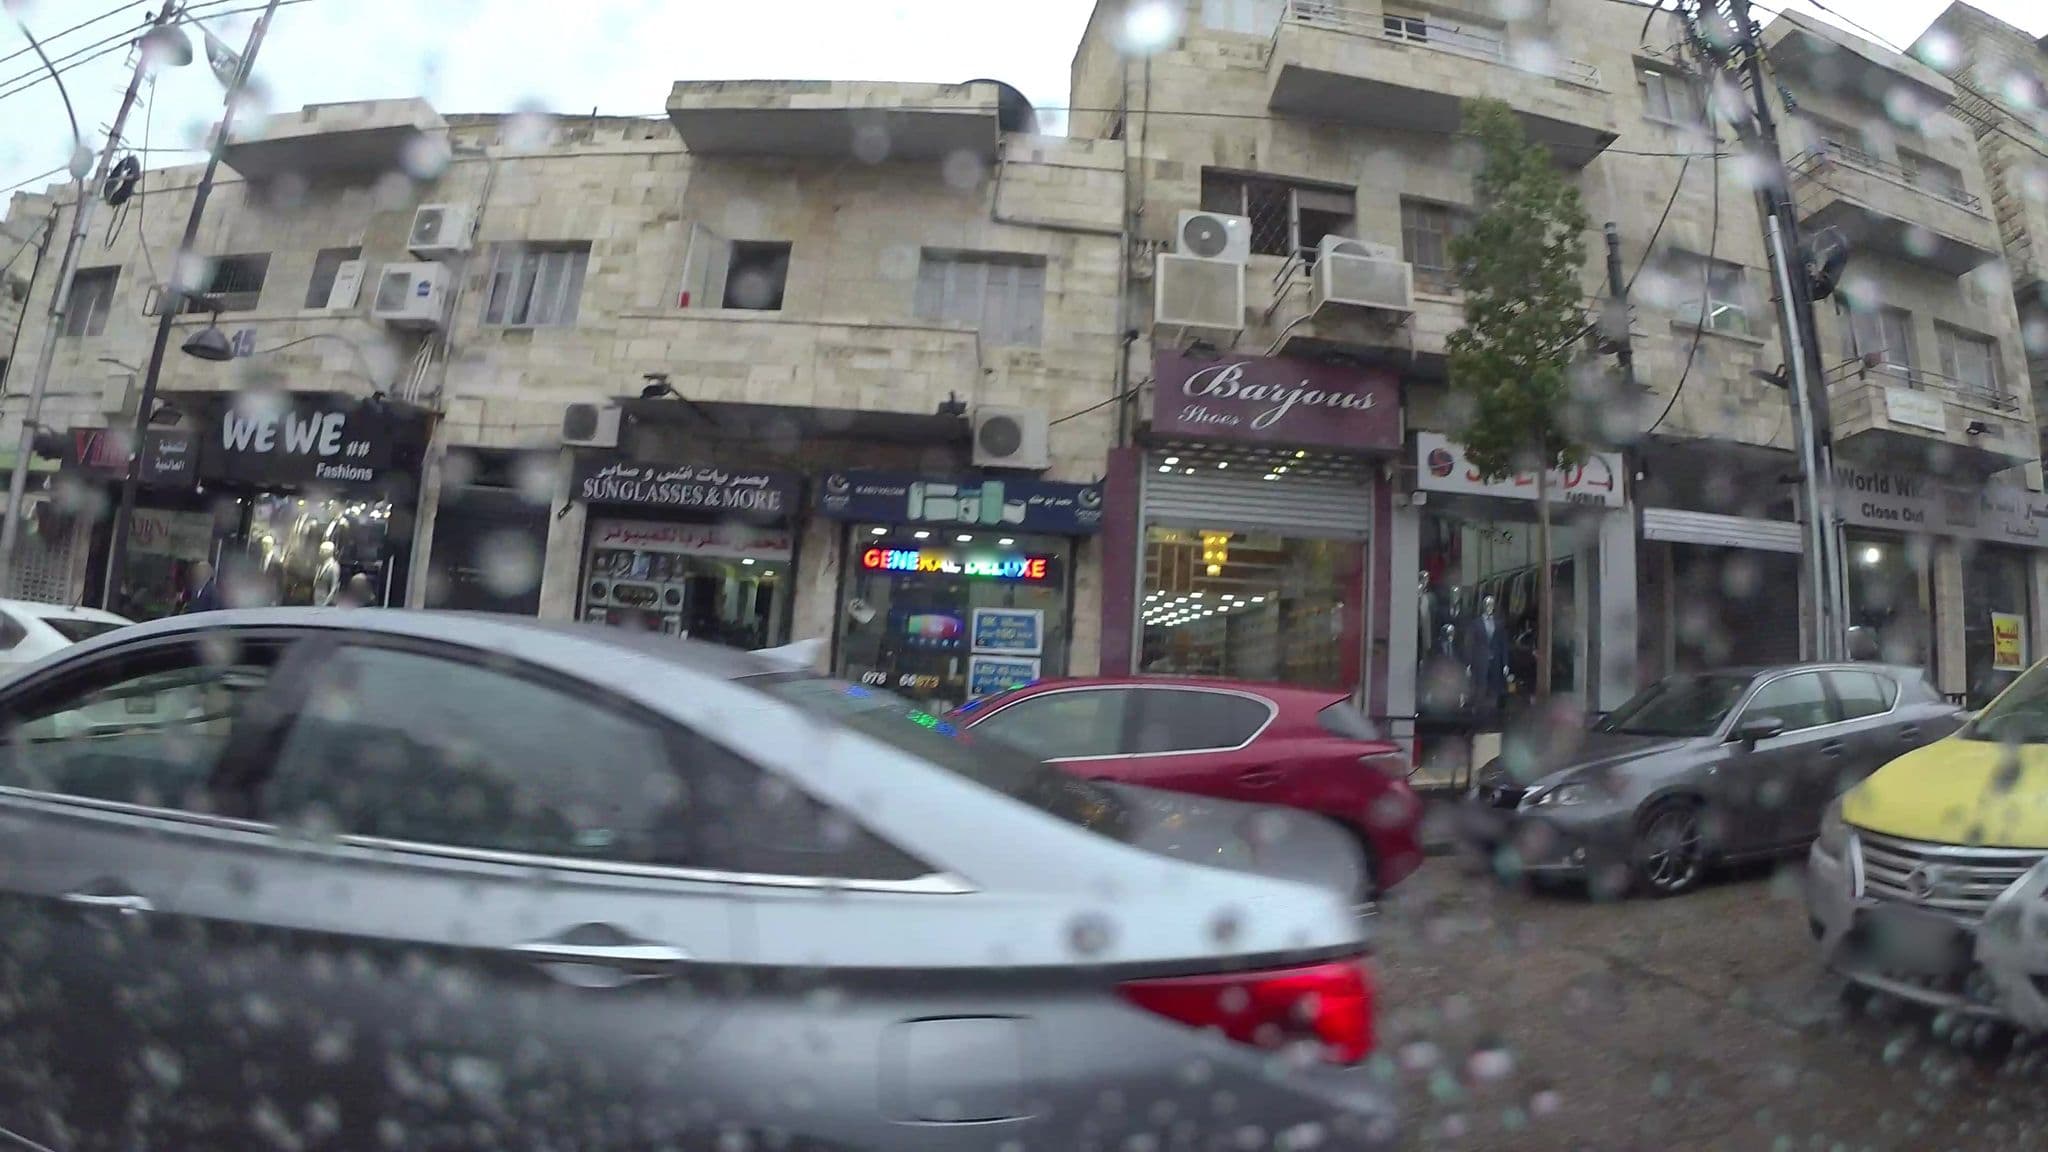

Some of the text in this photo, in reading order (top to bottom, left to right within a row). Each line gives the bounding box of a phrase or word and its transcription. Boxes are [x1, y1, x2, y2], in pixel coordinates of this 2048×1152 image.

[232, 329, 256, 357] 15
[1177, 404, 1240, 426] Shoes
[223, 410, 280, 453] WE
[285, 411, 346, 456] WE
[315, 462, 373, 481] Fashions
[1838, 466, 1890, 494] World
[1861, 502, 1899, 521] Close
[863, 548, 1047, 579] GENERAL DELUXE
